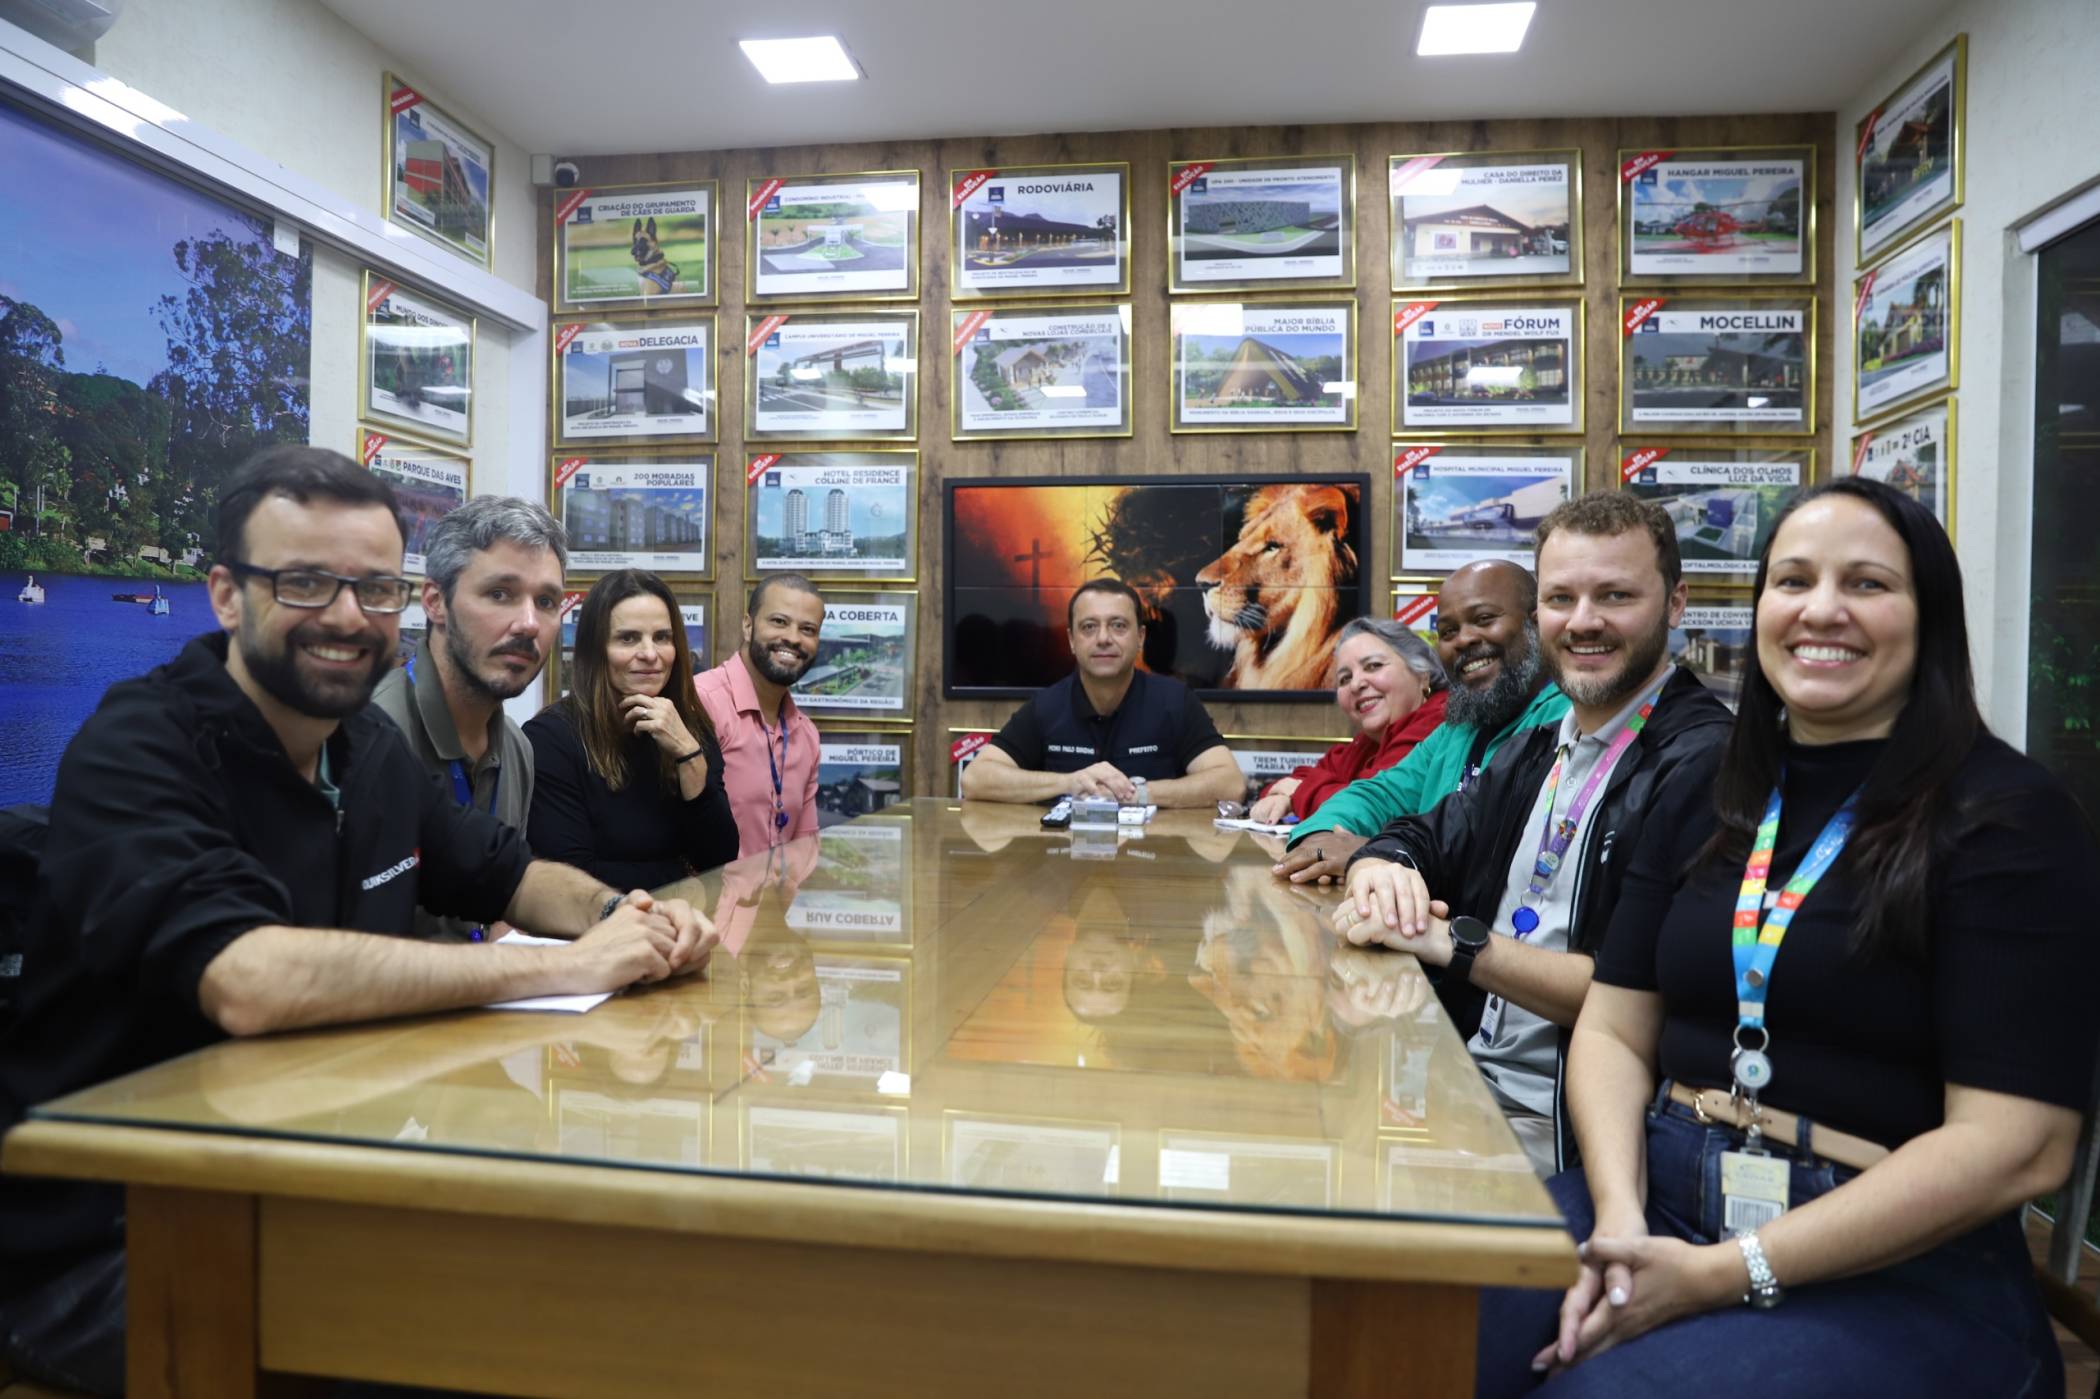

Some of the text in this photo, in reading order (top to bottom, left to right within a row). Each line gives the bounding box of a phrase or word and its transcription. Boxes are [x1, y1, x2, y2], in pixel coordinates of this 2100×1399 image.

[1668, 167, 1795, 177] HANGAR MIGUEL PEREIRA
[1018, 182, 1094, 194] RODOVIÁRIA
[598, 202, 631, 212] CRIAÇÃO
[645, 200, 696, 209] GRUPAMENTO
[417, 314, 428, 323] DOS
[1504, 316, 1560, 330] FÓRUM
[1700, 316, 1795, 329] MOCELLIN
[640, 336, 698, 347] DELEGACIA
[1914, 424, 1930, 445] CIA
[403, 461, 461, 484] PARQUE DAS AVES
[1690, 465, 1730, 475] CLÍNICA
[839, 610, 898, 622] COBERTA
[847, 747, 883, 756] PÓRTICO
[1129, 745, 1158, 755] PREFEITO
